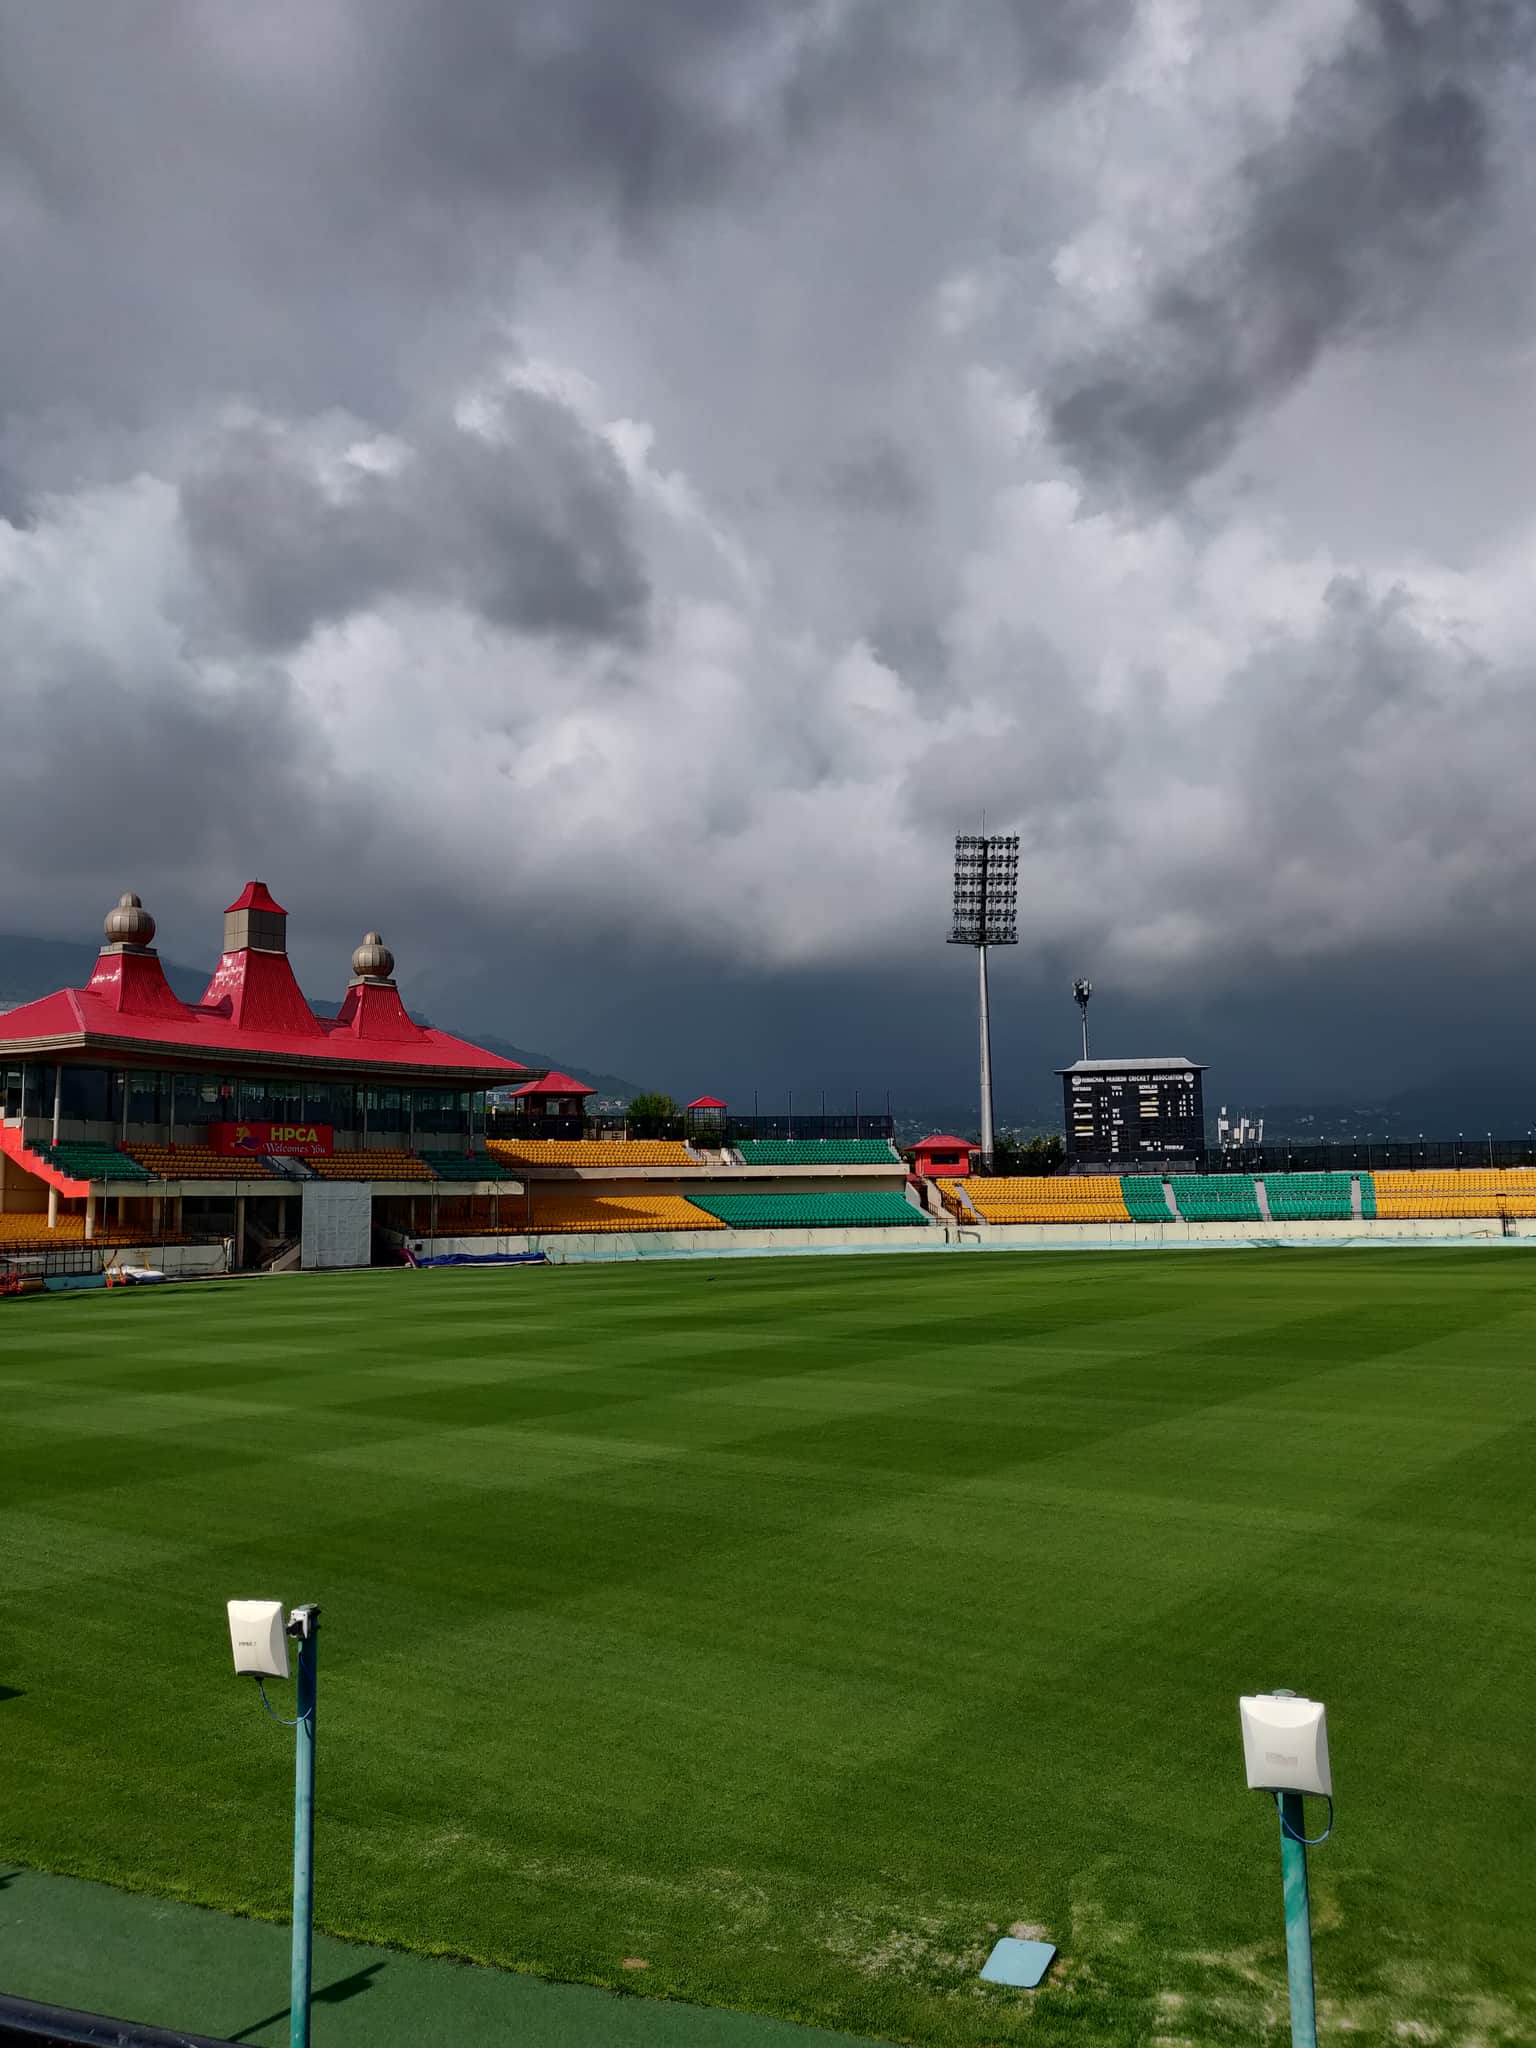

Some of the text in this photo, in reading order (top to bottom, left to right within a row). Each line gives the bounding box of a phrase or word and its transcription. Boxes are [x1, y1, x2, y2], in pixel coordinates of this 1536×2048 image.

[271, 1127, 318, 1142] HPCA
[263, 1142, 326, 1154] Welcomes You
